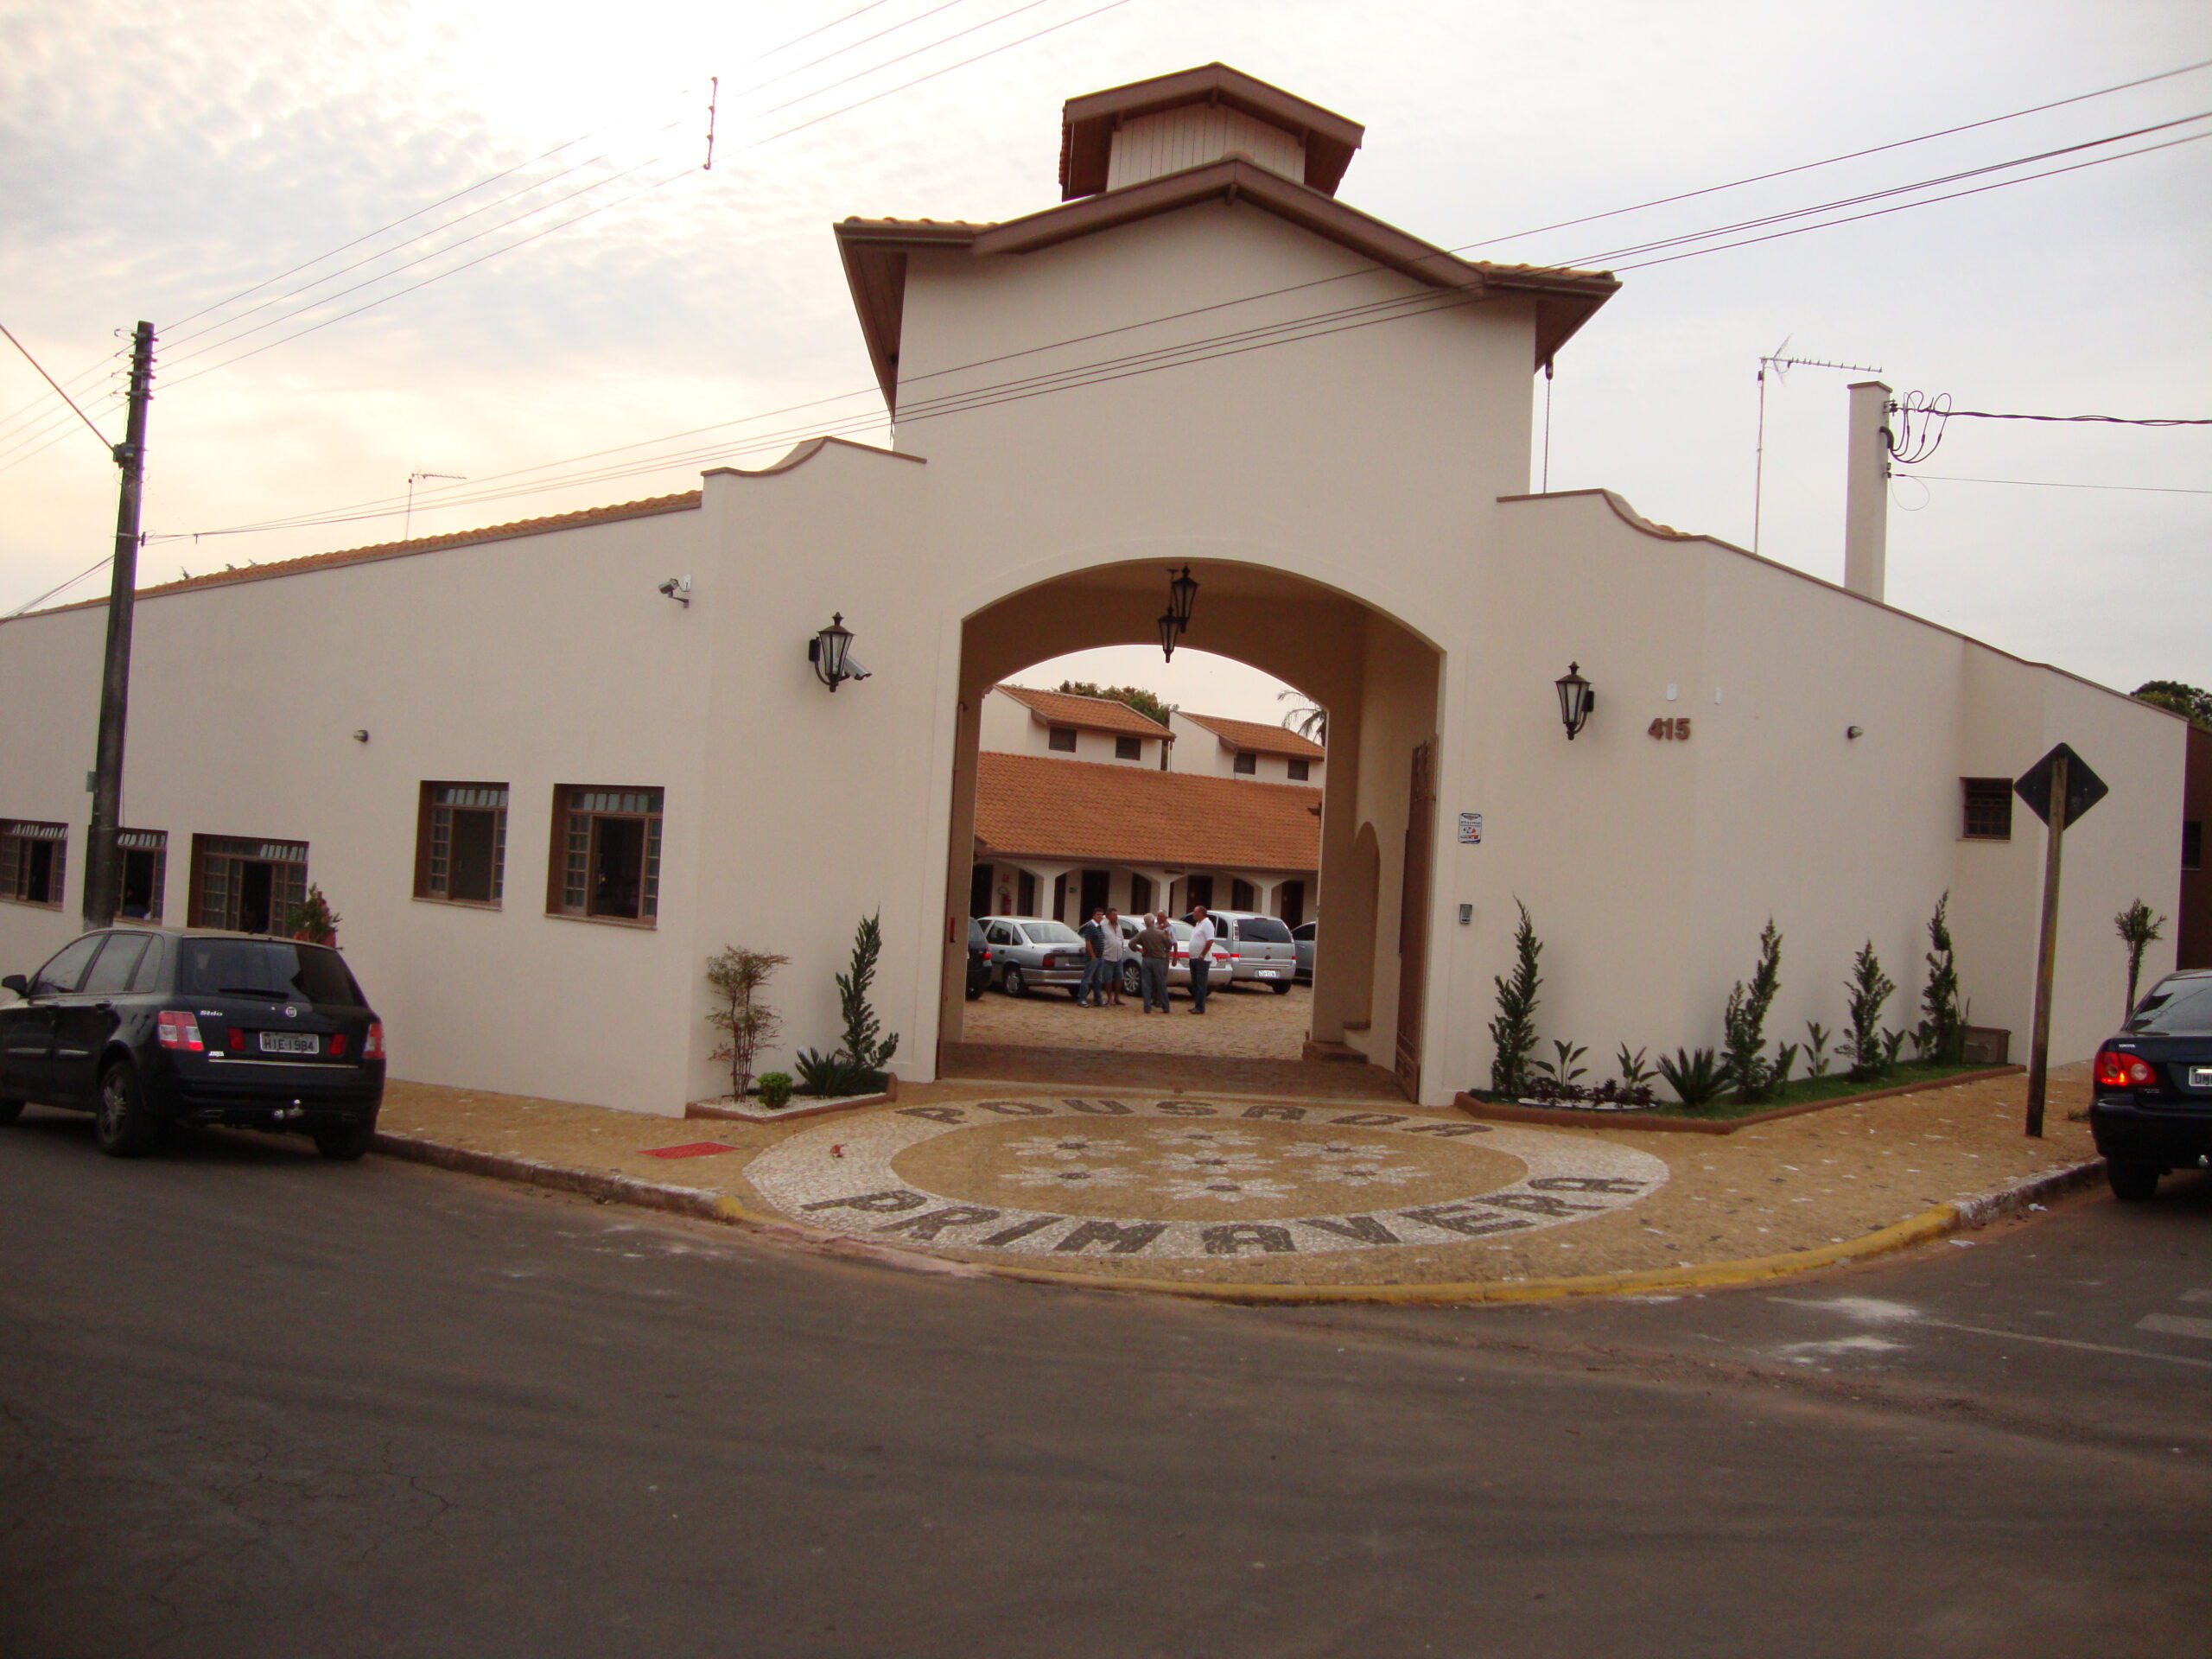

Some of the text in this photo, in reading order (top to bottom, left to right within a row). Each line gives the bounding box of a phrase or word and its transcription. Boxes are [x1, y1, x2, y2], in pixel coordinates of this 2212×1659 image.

[1647, 717, 1691, 741] 415
[893, 1100, 1494, 1137] POUSADA
[799, 1177, 1648, 1254] PRIMAVERA
